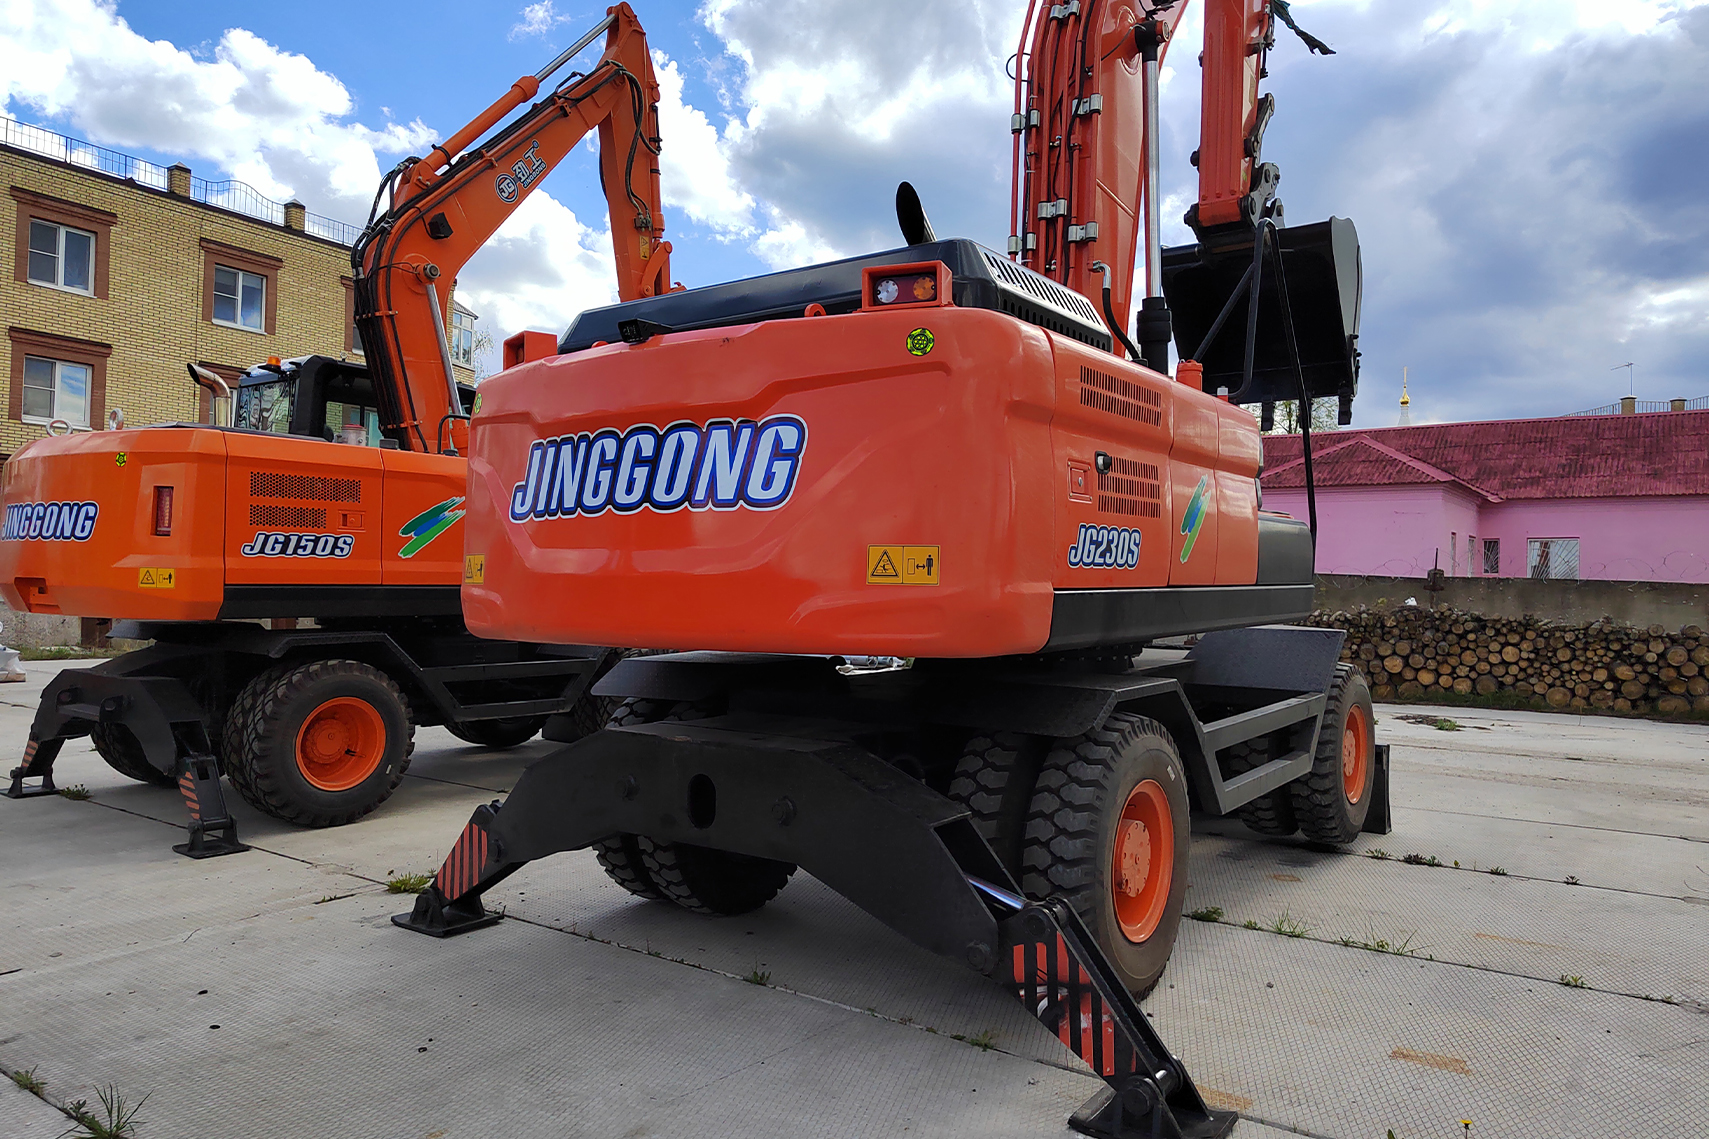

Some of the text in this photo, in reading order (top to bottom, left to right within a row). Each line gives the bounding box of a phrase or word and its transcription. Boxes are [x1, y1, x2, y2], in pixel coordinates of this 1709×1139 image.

[512, 420, 804, 518] JINGGONG
[2, 503, 97, 540] JINGGONG
[243, 533, 354, 557] JG150S
[1069, 526, 1140, 567] JG230S
